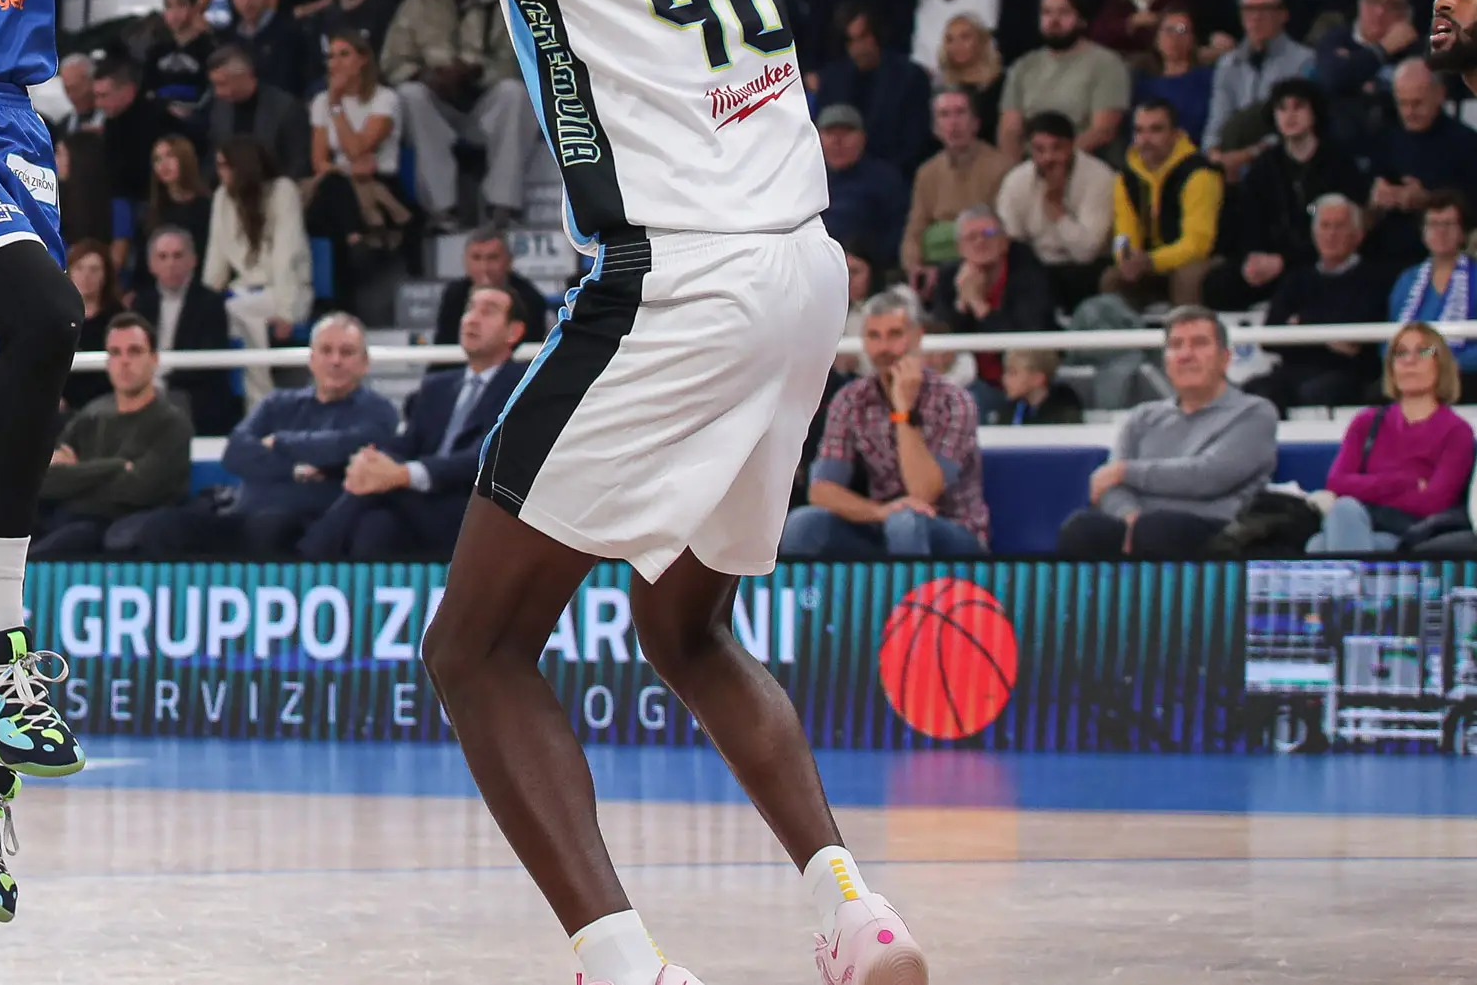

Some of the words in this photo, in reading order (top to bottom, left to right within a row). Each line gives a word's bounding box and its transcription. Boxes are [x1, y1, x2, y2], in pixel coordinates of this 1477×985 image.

[702, 62, 795, 119] Milwaukee
[60, 585, 351, 660] GRUPPO
[65, 678, 338, 725] SERVIZI
